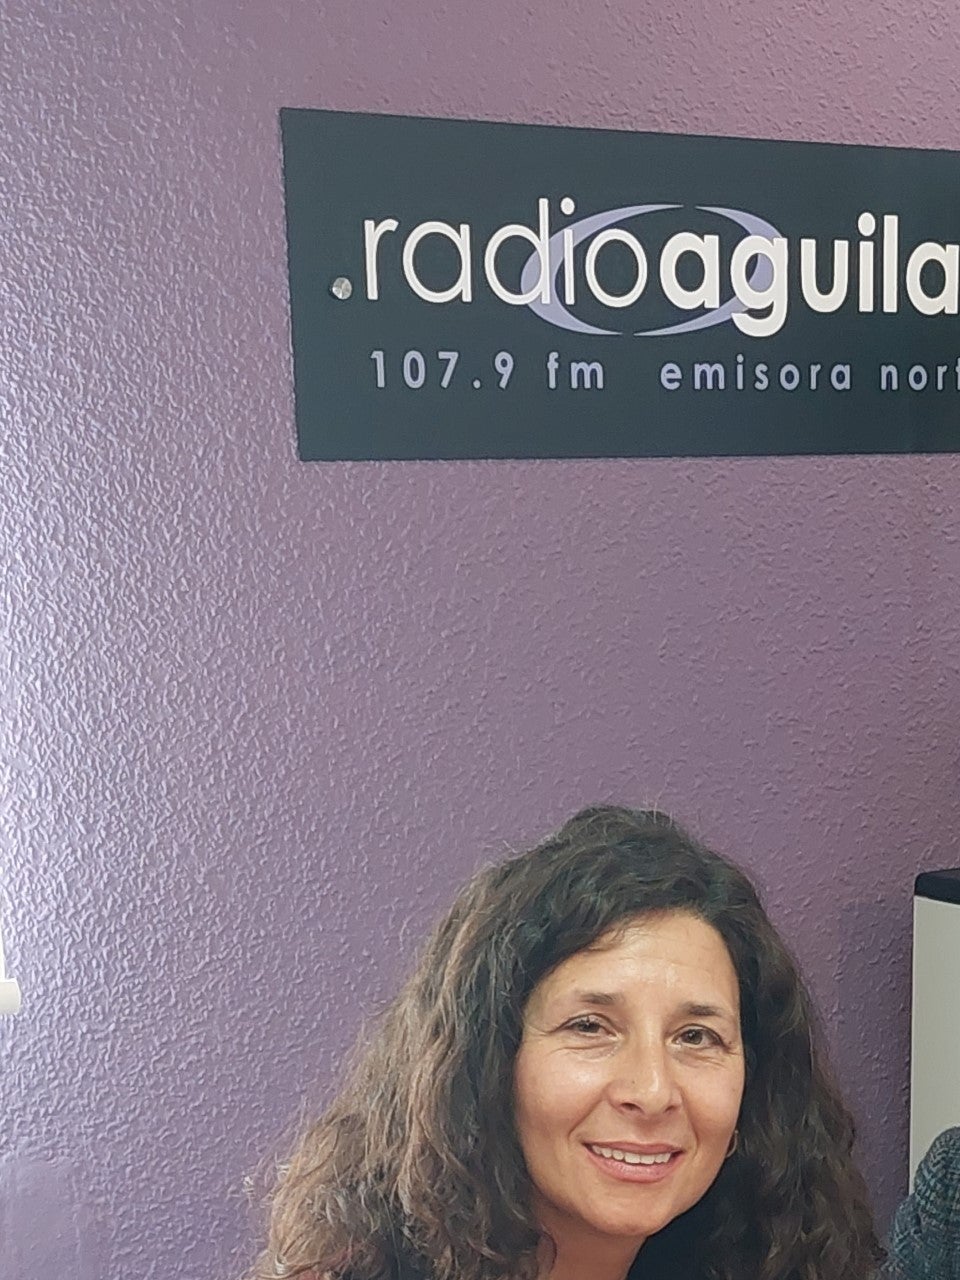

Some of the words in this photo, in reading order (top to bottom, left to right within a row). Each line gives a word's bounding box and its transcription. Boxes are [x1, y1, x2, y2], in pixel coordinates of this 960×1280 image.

[371, 351, 514, 391] 107.9
[547, 353, 604, 390] fm
[660, 354, 851, 391] emisora
